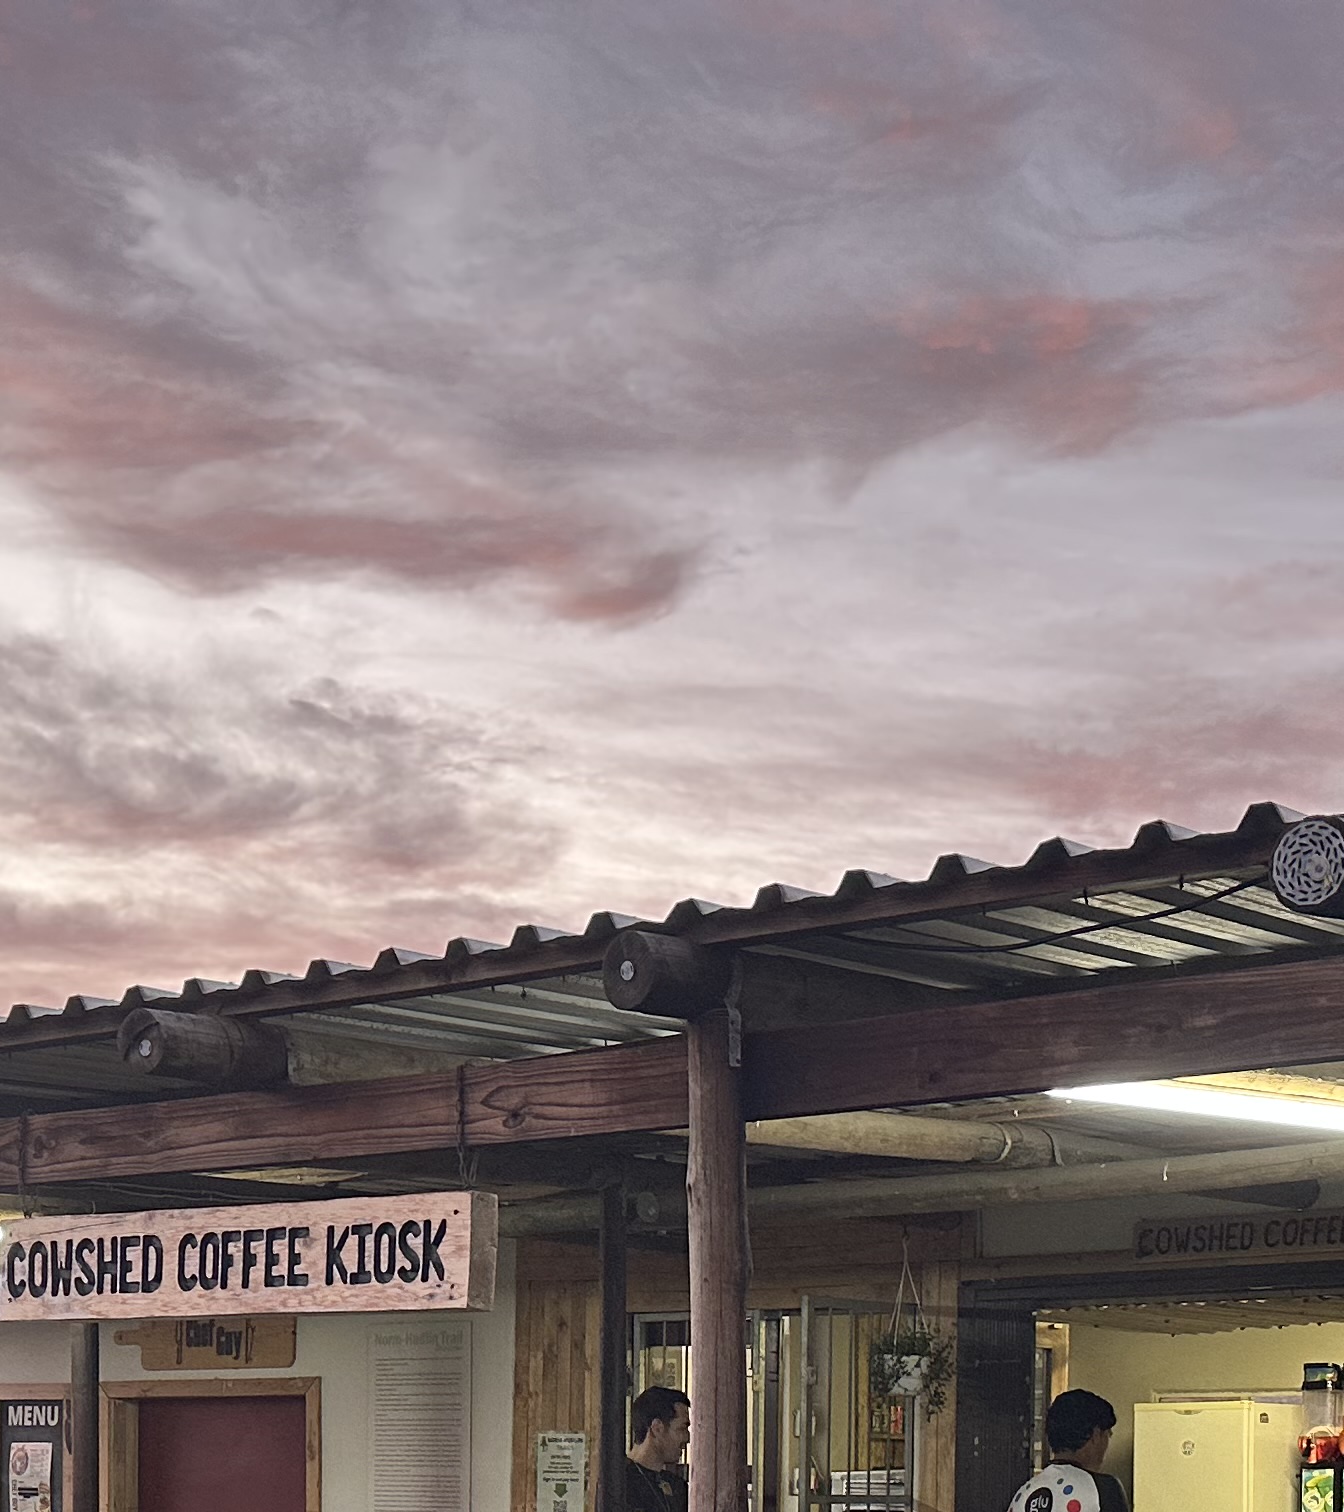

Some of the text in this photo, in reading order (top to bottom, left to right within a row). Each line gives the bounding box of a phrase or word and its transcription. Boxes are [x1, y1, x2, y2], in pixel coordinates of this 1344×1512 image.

[7, 1218, 448, 1298] COWSHED COFFEE KIOSK
[1136, 1221, 1254, 1258] COWSHED
[8, 1405, 59, 1426] MENU
